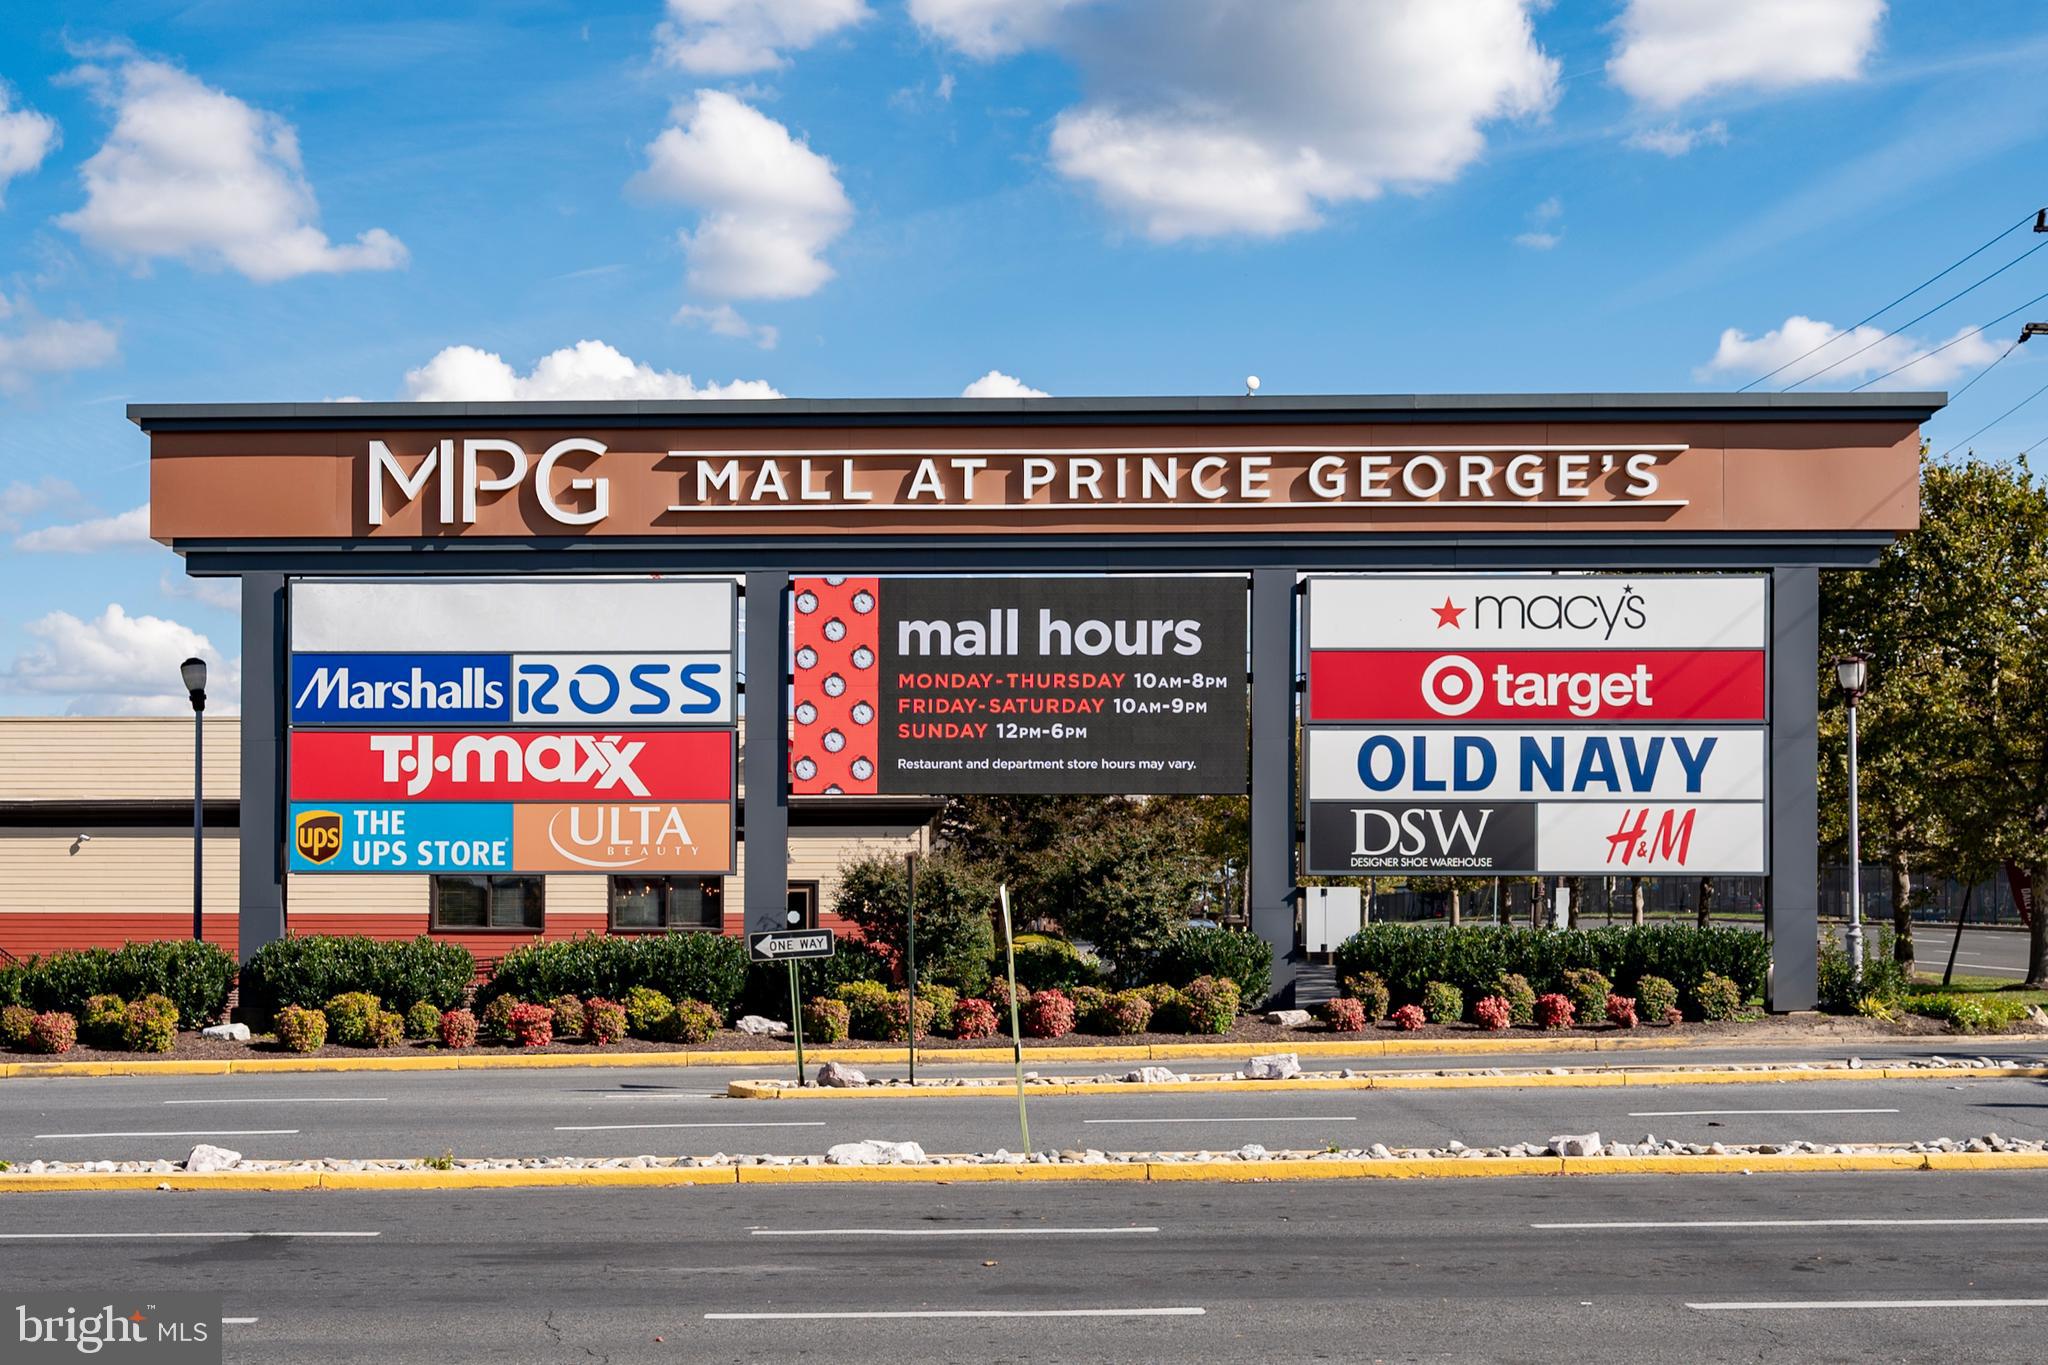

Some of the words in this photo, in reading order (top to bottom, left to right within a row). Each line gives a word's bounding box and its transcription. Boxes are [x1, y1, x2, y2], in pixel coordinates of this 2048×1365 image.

[367, 438, 610, 526] MPG
[696, 458, 873, 502] MALL
[907, 457, 988, 501] AT
[1022, 456, 1273, 500] PRINCE
[1308, 453, 1660, 499] GEORGE'S
[897, 608, 1019, 656] mall
[1039, 608, 1203, 656] hours
[1474, 584, 1647, 641] macy's
[295, 667, 504, 710] Marshalls
[518, 663, 722, 715] ROSS
[898, 672, 1126, 690] MONDAY-THURSDAY
[1133, 672, 1228, 690] 10AM-8PM
[1492, 664, 1653, 718] target
[898, 698, 1105, 715] FRIDAY-SATURDAY
[1113, 697, 1208, 715] 10AM-9PM
[898, 723, 988, 740] SUNDAY
[996, 722, 1088, 740] 12PM-6PM
[898, 758, 963, 770] Restaurant
[966, 758, 990, 770] and
[992, 758, 1065, 773] department
[1067, 759, 1098, 770] store
[1101, 758, 1136, 770] hours
[1139, 760, 1165, 773] may
[1168, 760, 1197, 773] vary.
[1357, 735, 1498, 792] OLD
[1519, 736, 1719, 793] NAVY
[299, 826, 340, 850] ups
[353, 810, 405, 835] THE
[569, 806, 693, 845] ULTA
[1350, 808, 1494, 856] DSW
[1606, 808, 1697, 866] H&M
[352, 841, 407, 866] UPS
[417, 840, 506, 866] STORE
[607, 846, 700, 856] BEAUTY
[1350, 857, 1399, 868] DESIGNER
[1400, 857, 1428, 867] SHOE
[1429, 857, 1493, 867] WAREHOUSE
[769, 941, 793, 951] ONE
[800, 937, 825, 949] WAY
